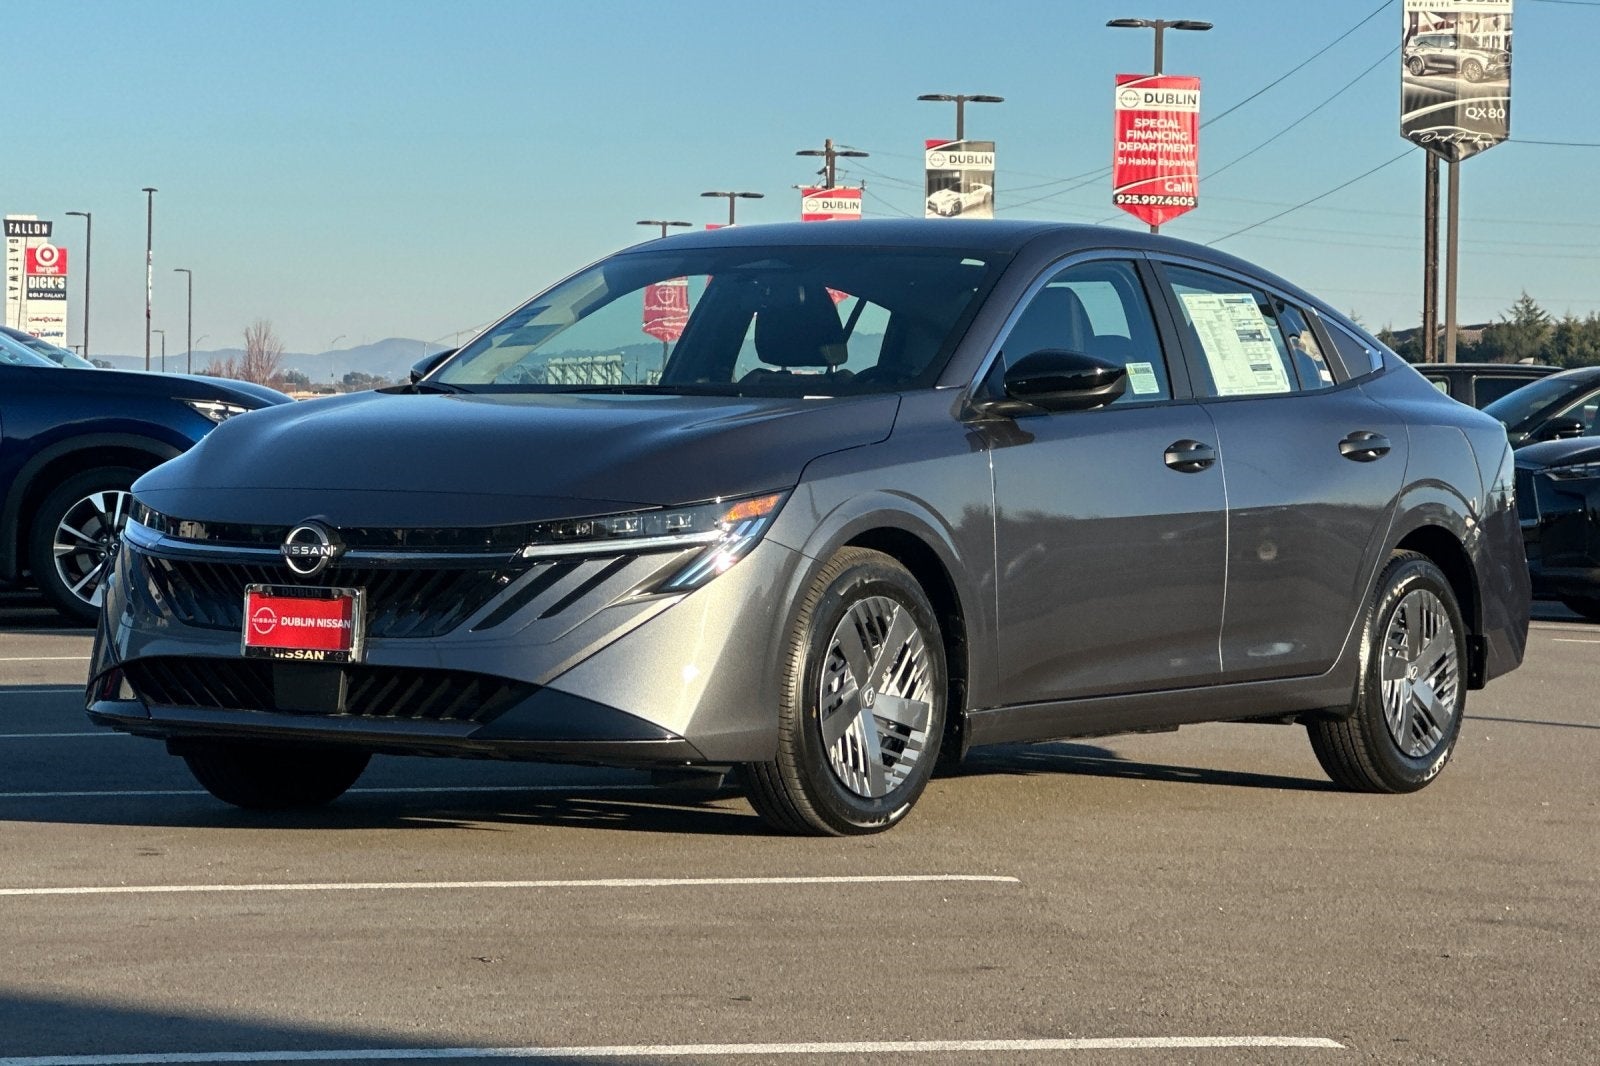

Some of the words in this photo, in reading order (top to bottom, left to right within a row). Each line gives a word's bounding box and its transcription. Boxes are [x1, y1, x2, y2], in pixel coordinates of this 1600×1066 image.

[1144, 93, 1197, 105] DUBLIN
[1465, 107, 1505, 119] QX80
[1134, 118, 1180, 128] SPECIAL
[1126, 130, 1188, 140] FINANCING
[1118, 142, 1195, 152] DEPARTMENT
[949, 155, 992, 164] DUBLIN
[1128, 157, 1157, 166] Habla
[1117, 194, 1195, 206] 925.997.4505
[822, 201, 859, 210] DUBLIN
[9, 223, 48, 234] FALLON
[9, 239, 19, 300] GATEWAY
[28, 276, 65, 289] DICK'S
[280, 546, 331, 555] NISSAN
[281, 616, 315, 627] DUBLIN
[316, 618, 351, 629] NISSAN
